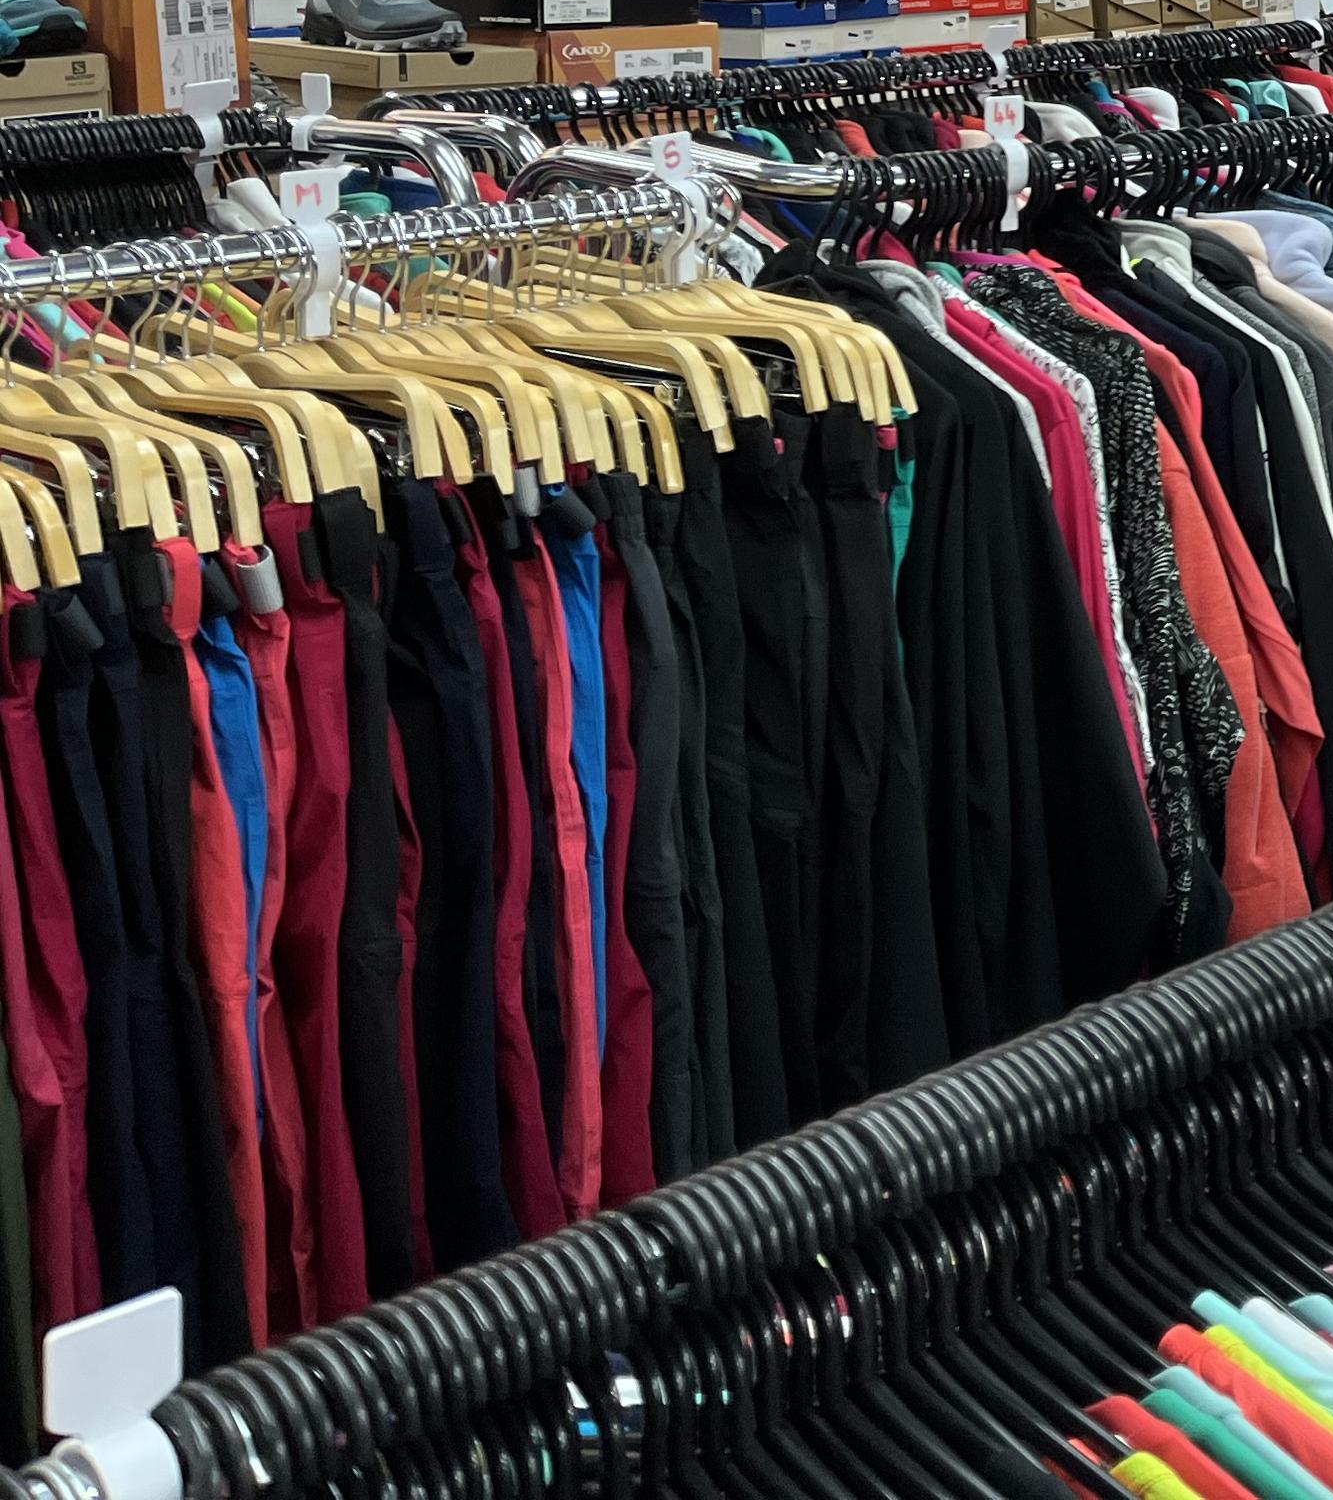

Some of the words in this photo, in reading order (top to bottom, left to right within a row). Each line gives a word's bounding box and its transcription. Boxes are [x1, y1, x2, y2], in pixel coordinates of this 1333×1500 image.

[994, 102, 1016, 125] 44
[663, 139, 681, 168] S
[295, 182, 322, 207] M
